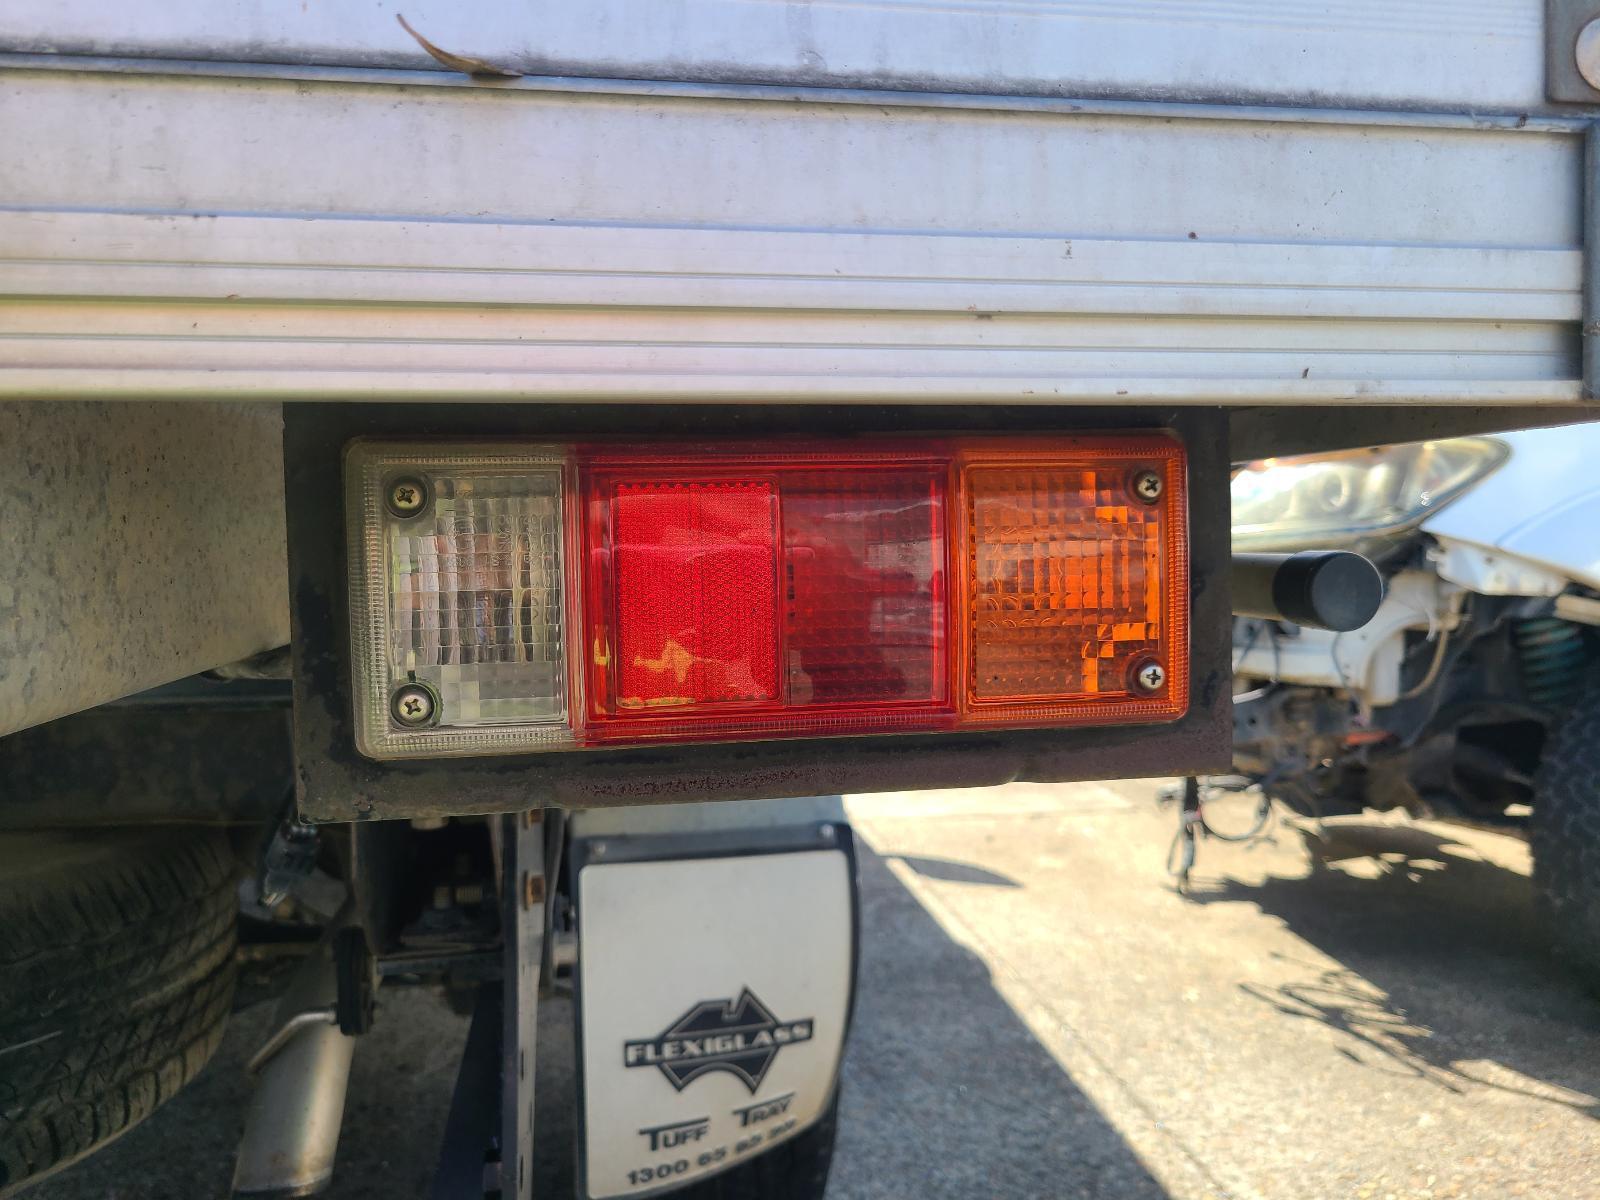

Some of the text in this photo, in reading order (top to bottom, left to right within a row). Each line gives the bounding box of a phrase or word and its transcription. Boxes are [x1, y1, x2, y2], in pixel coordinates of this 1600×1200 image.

[626, 1022, 811, 1063] FLEXIGLASS
[638, 1116, 711, 1152] TUFF
[732, 1091, 796, 1128] TRAY
[627, 1158, 690, 1185] 1300
